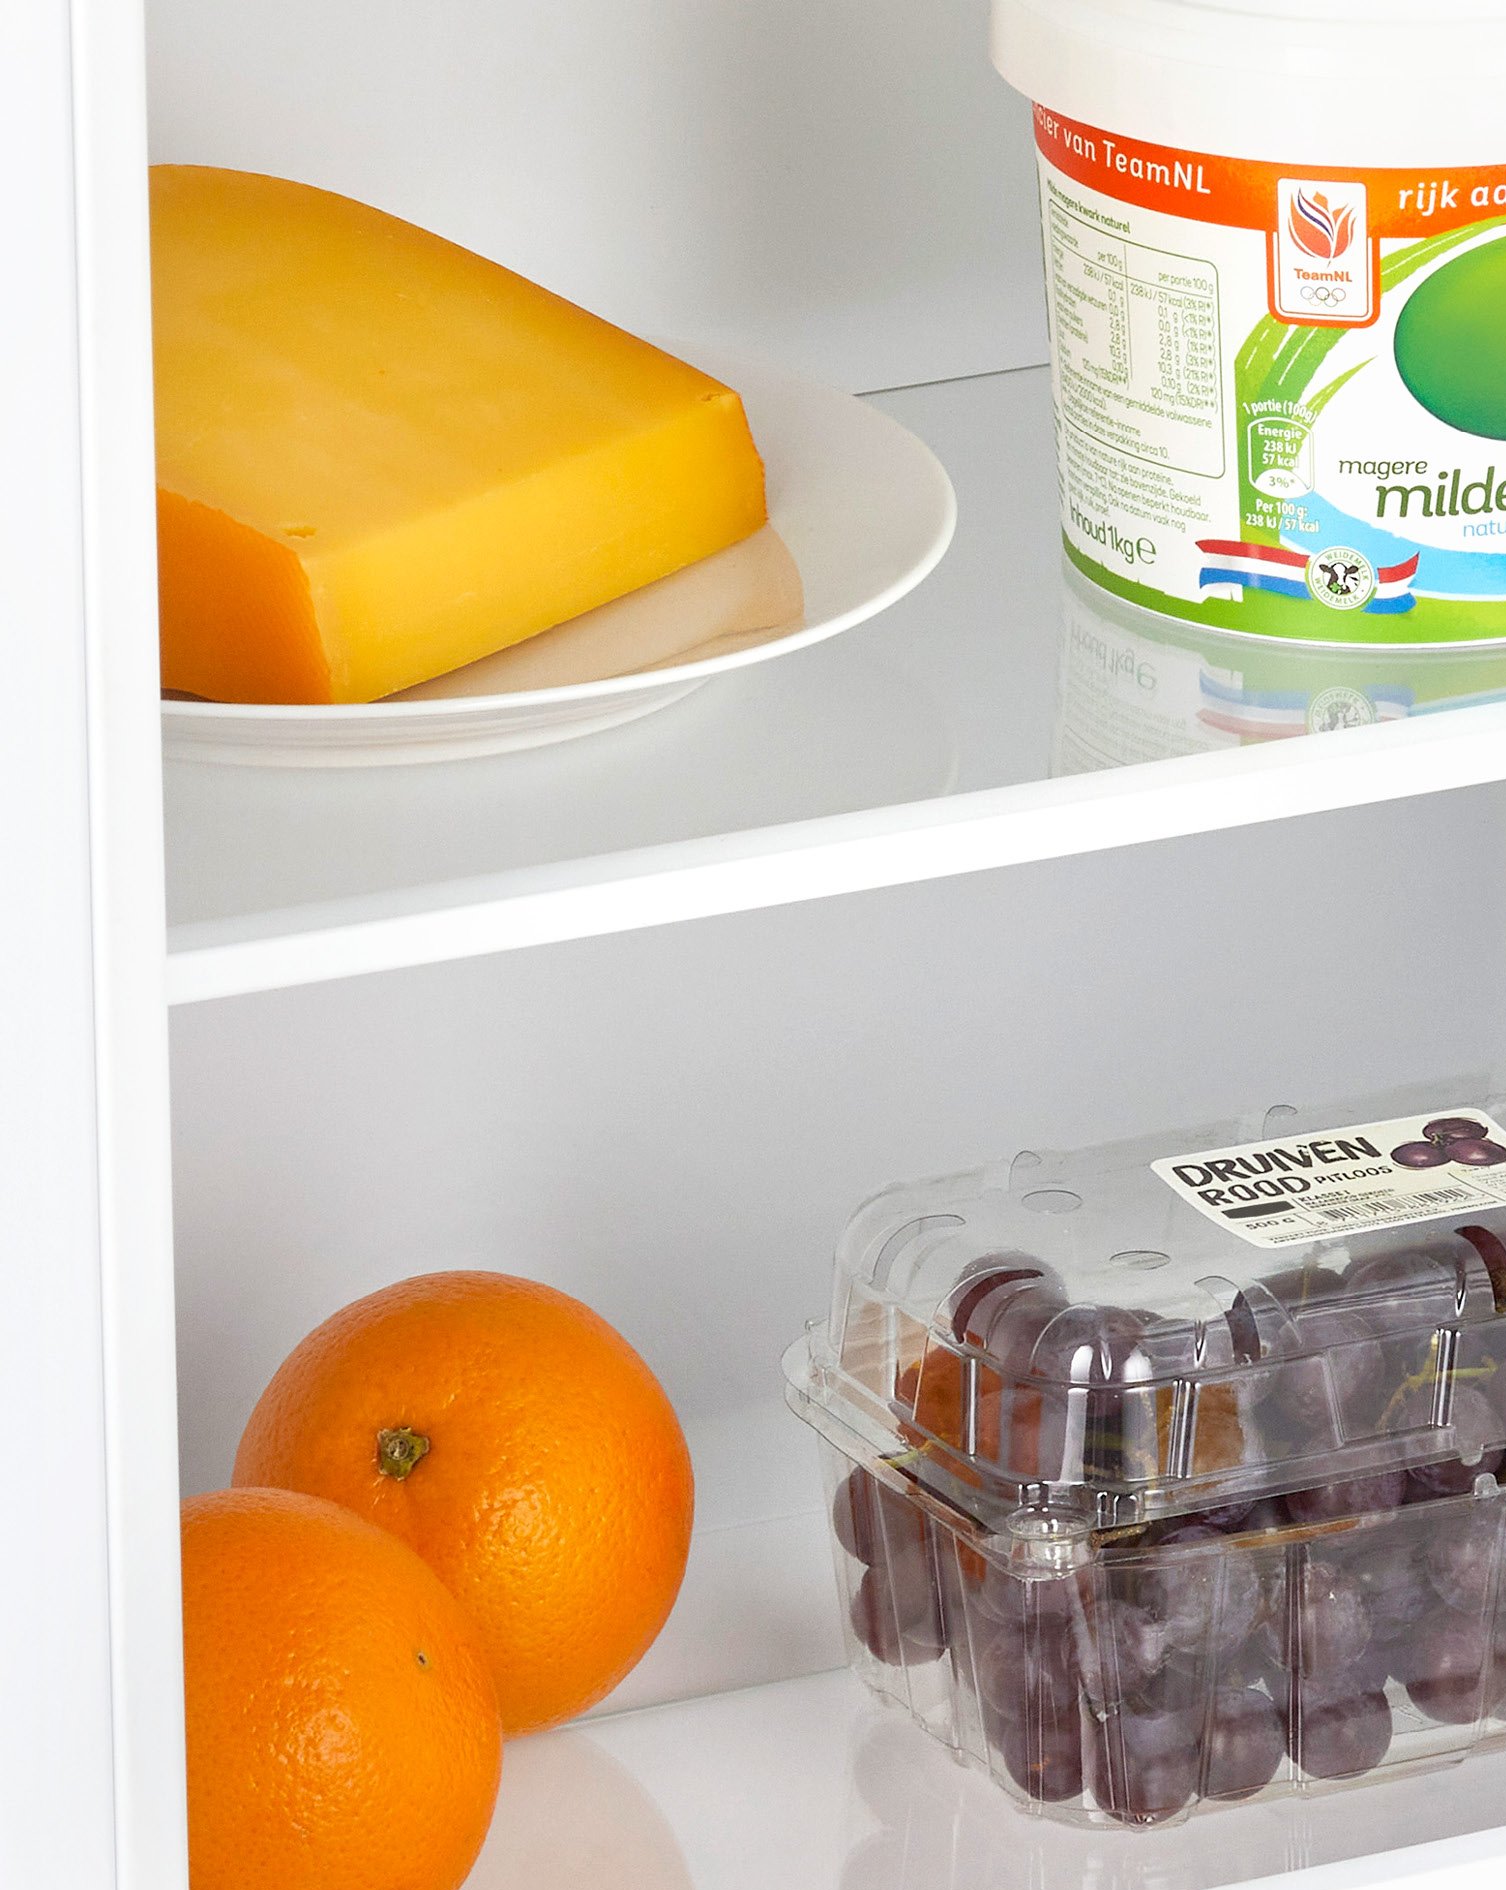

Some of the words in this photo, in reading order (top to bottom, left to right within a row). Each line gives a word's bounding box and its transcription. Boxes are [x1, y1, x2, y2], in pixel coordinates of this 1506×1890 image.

[1063, 127, 1097, 163] van
[1102, 139, 1211, 195] TeamNL
[1398, 181, 1460, 218] rijk
[1101, 215, 1131, 234] naturel
[1293, 267, 1353, 284] TeamNL
[1251, 398, 1282, 416] portie
[1283, 399, 1318, 424] (100g)
[1257, 423, 1303, 440] Energie
[1263, 440, 1284, 453] 238
[1284, 441, 1297, 454] kJ
[1262, 453, 1276, 464] 57
[1276, 454, 1299, 468] kcal
[1338, 459, 1428, 480] magere
[1255, 498, 1275, 513] Per
[1276, 501, 1295, 515] 100
[1297, 506, 1308, 519] g:
[1069, 497, 1107, 543] Inhoud
[1245, 513, 1266, 527] 238
[1266, 515, 1277, 529] kJ
[1284, 518, 1297, 530] 57
[1297, 519, 1319, 533] kcal
[1324, 551, 1369, 581] WEIDEMELK
[1313, 576, 1361, 605] WEIDEMELK
[1171, 1136, 1383, 1188] DRUIVEN
[1197, 1176, 1312, 1207] ROOD
[1314, 1165, 1394, 1185] PITLOOS
[1245, 1220, 1280, 1230] 500
